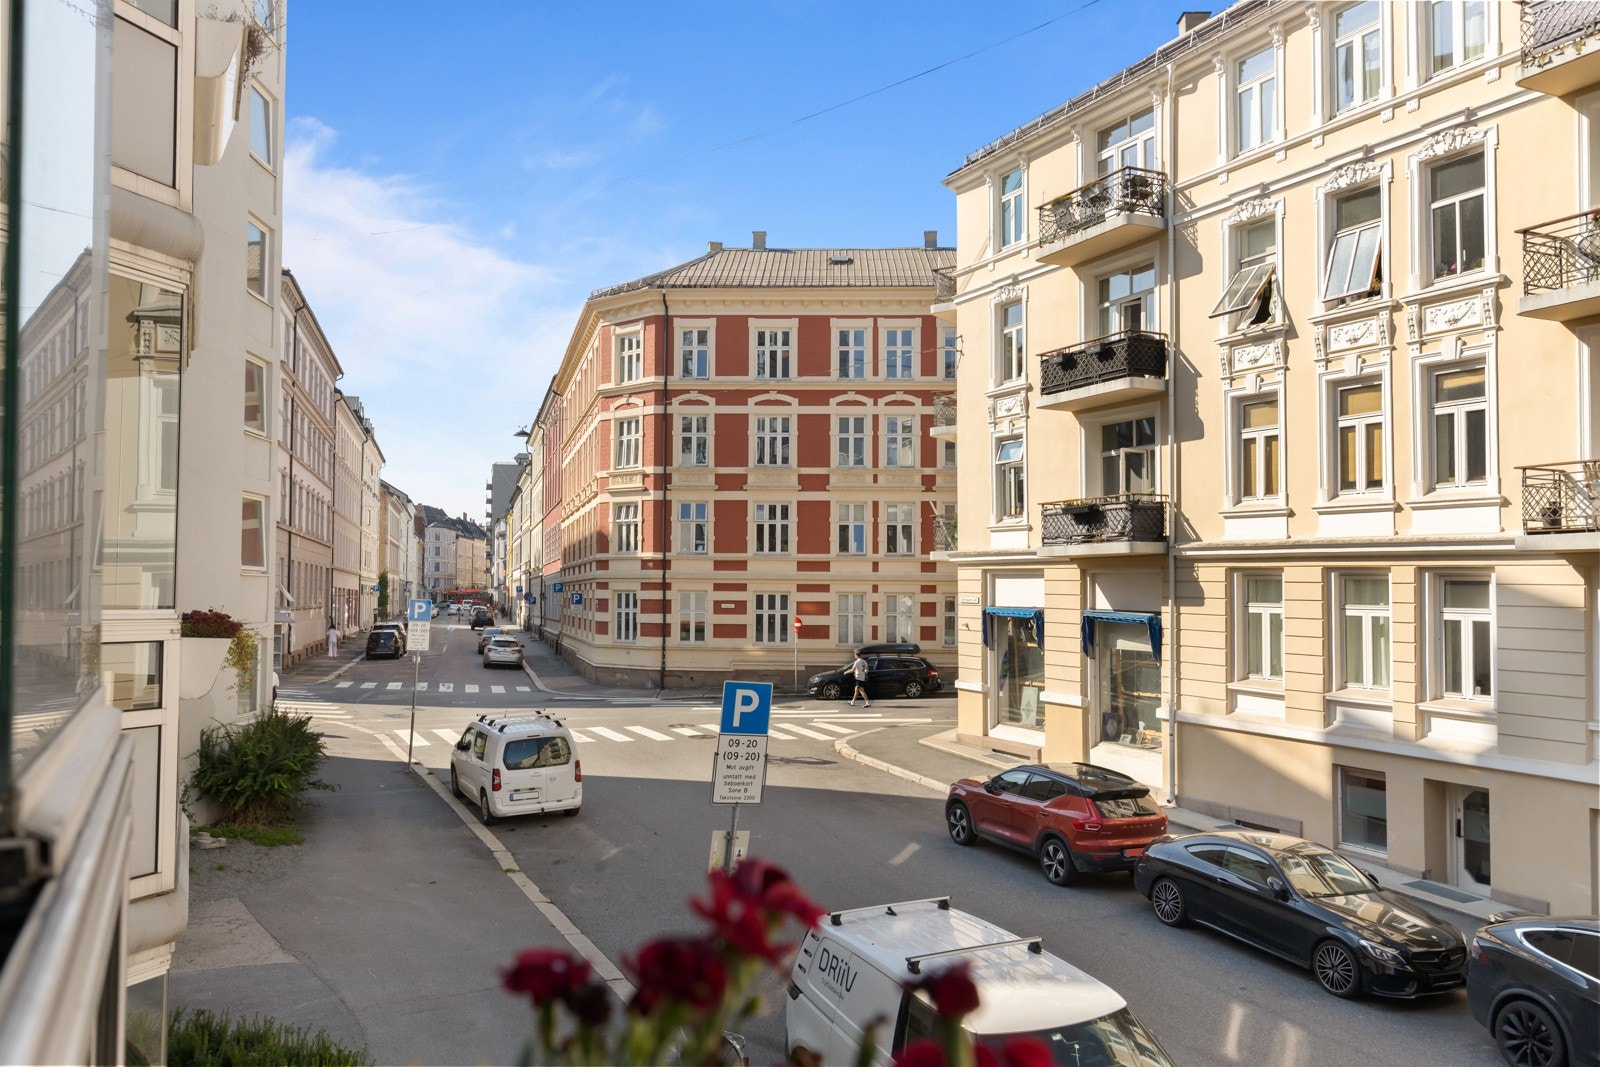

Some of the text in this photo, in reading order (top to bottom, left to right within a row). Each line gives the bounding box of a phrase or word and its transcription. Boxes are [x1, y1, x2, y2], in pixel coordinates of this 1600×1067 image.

[573, 594, 580, 604] P
[414, 602, 427, 619] P
[733, 689, 759, 727] P
